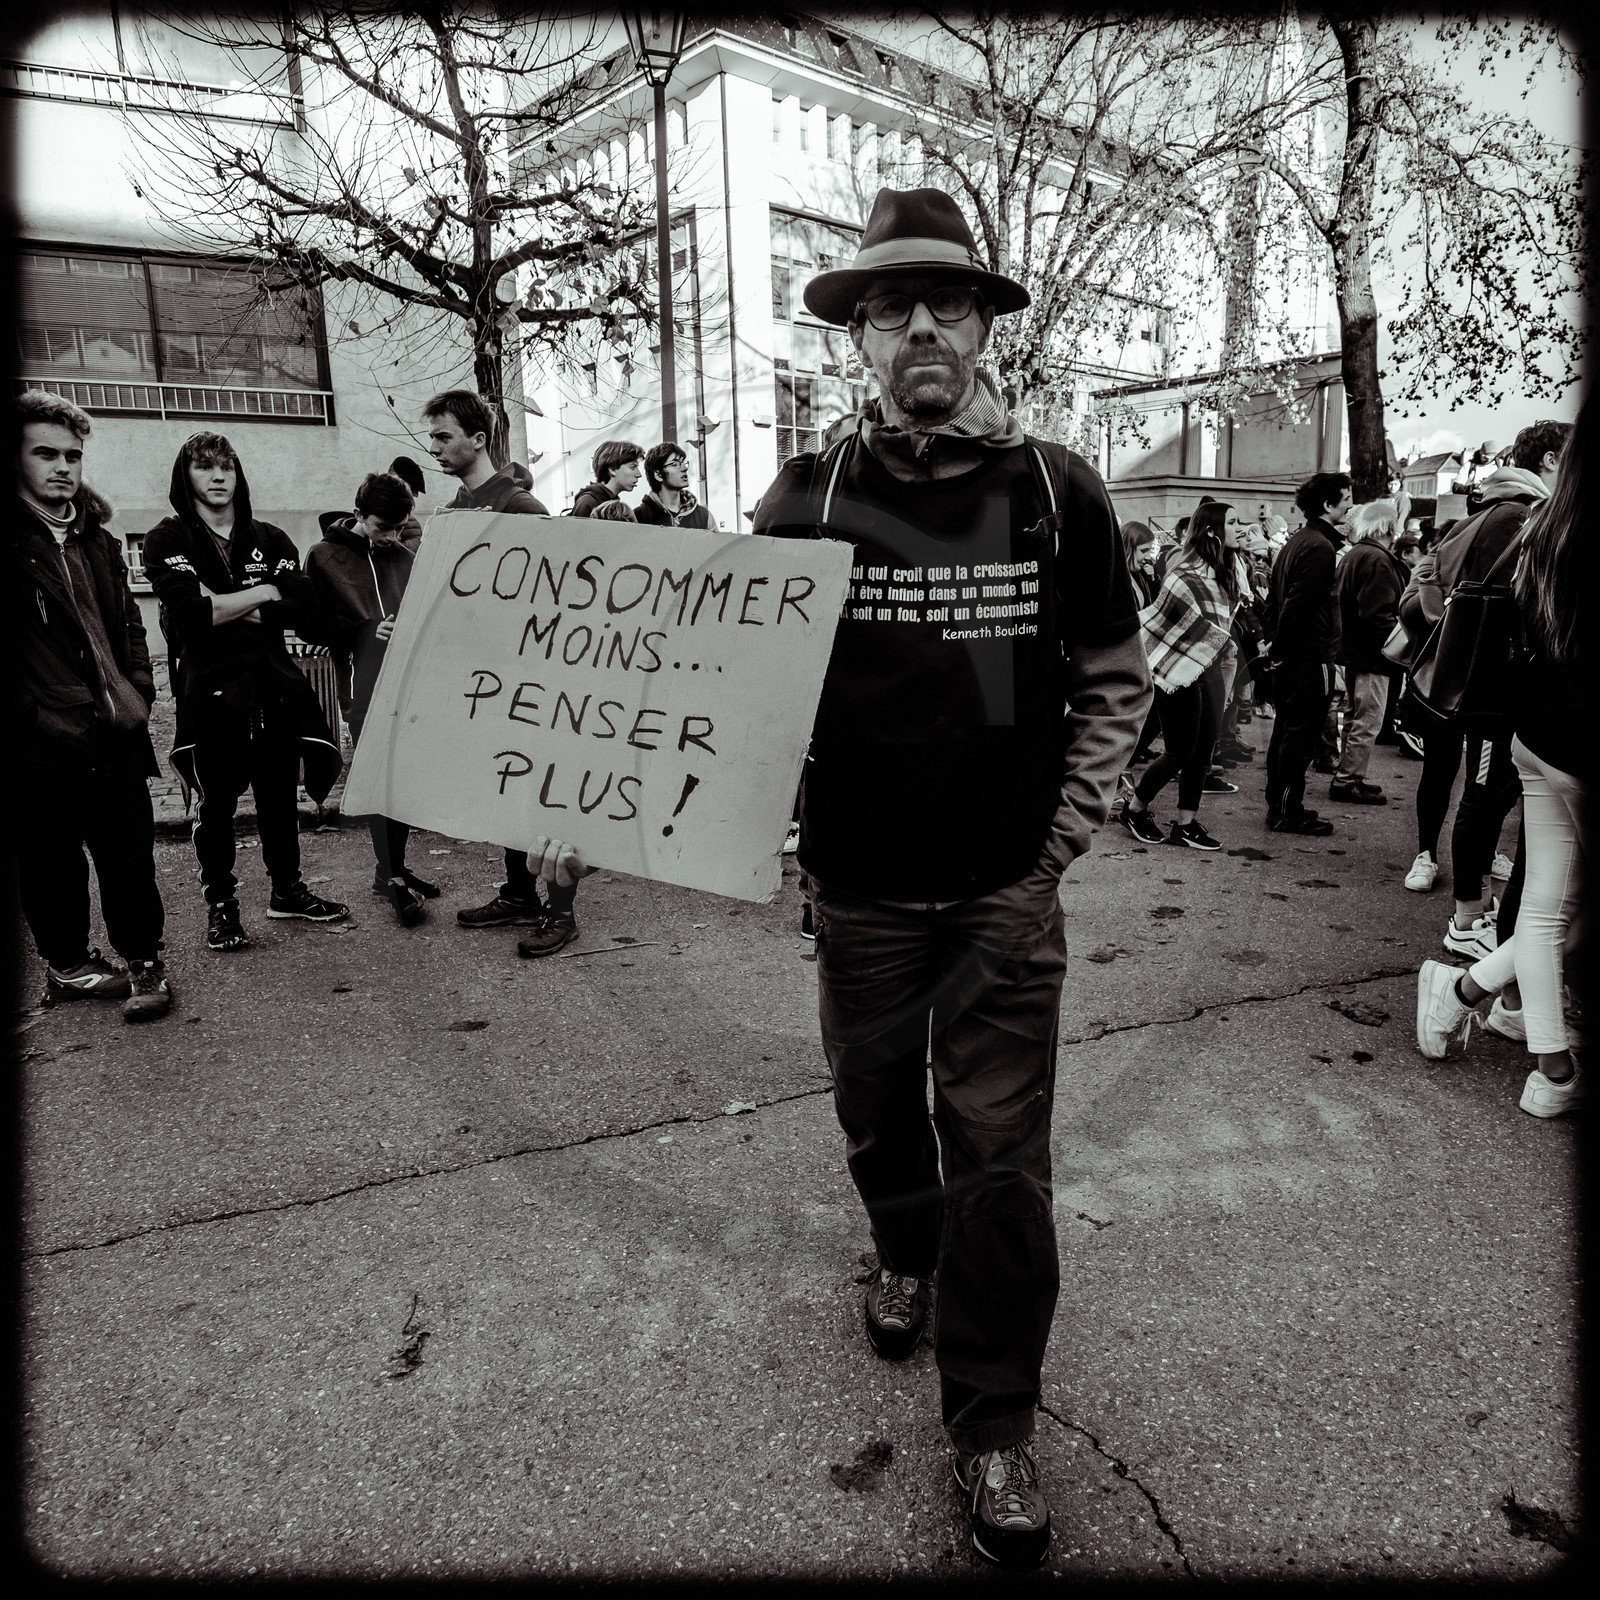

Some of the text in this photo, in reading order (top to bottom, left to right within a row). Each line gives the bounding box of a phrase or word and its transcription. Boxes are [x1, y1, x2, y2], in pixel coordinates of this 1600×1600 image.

[867, 566, 888, 582] qui
[892, 566, 923, 583] croit
[927, 566, 952, 583] que
[955, 564, 968, 580] la
[973, 560, 1039, 579] croissance
[449, 542, 816, 628] CONSOMMER
[859, 585, 883, 600] être
[887, 586, 925, 602] infinie
[928, 586, 958, 601] dans
[961, 586, 978, 600] un
[982, 583, 1017, 598] monde
[1021, 579, 1039, 595] fini
[852, 606, 873, 621] soit
[877, 608, 892, 622] un
[897, 606, 921, 623] fou,
[926, 606, 949, 622] soit
[953, 607, 970, 621] un
[975, 600, 1039, 620] économiste
[942, 622, 1038, 641] Kenneth Boulding
[463, 669, 717, 756] PENSER
[492, 750, 643, 822] PLUS
